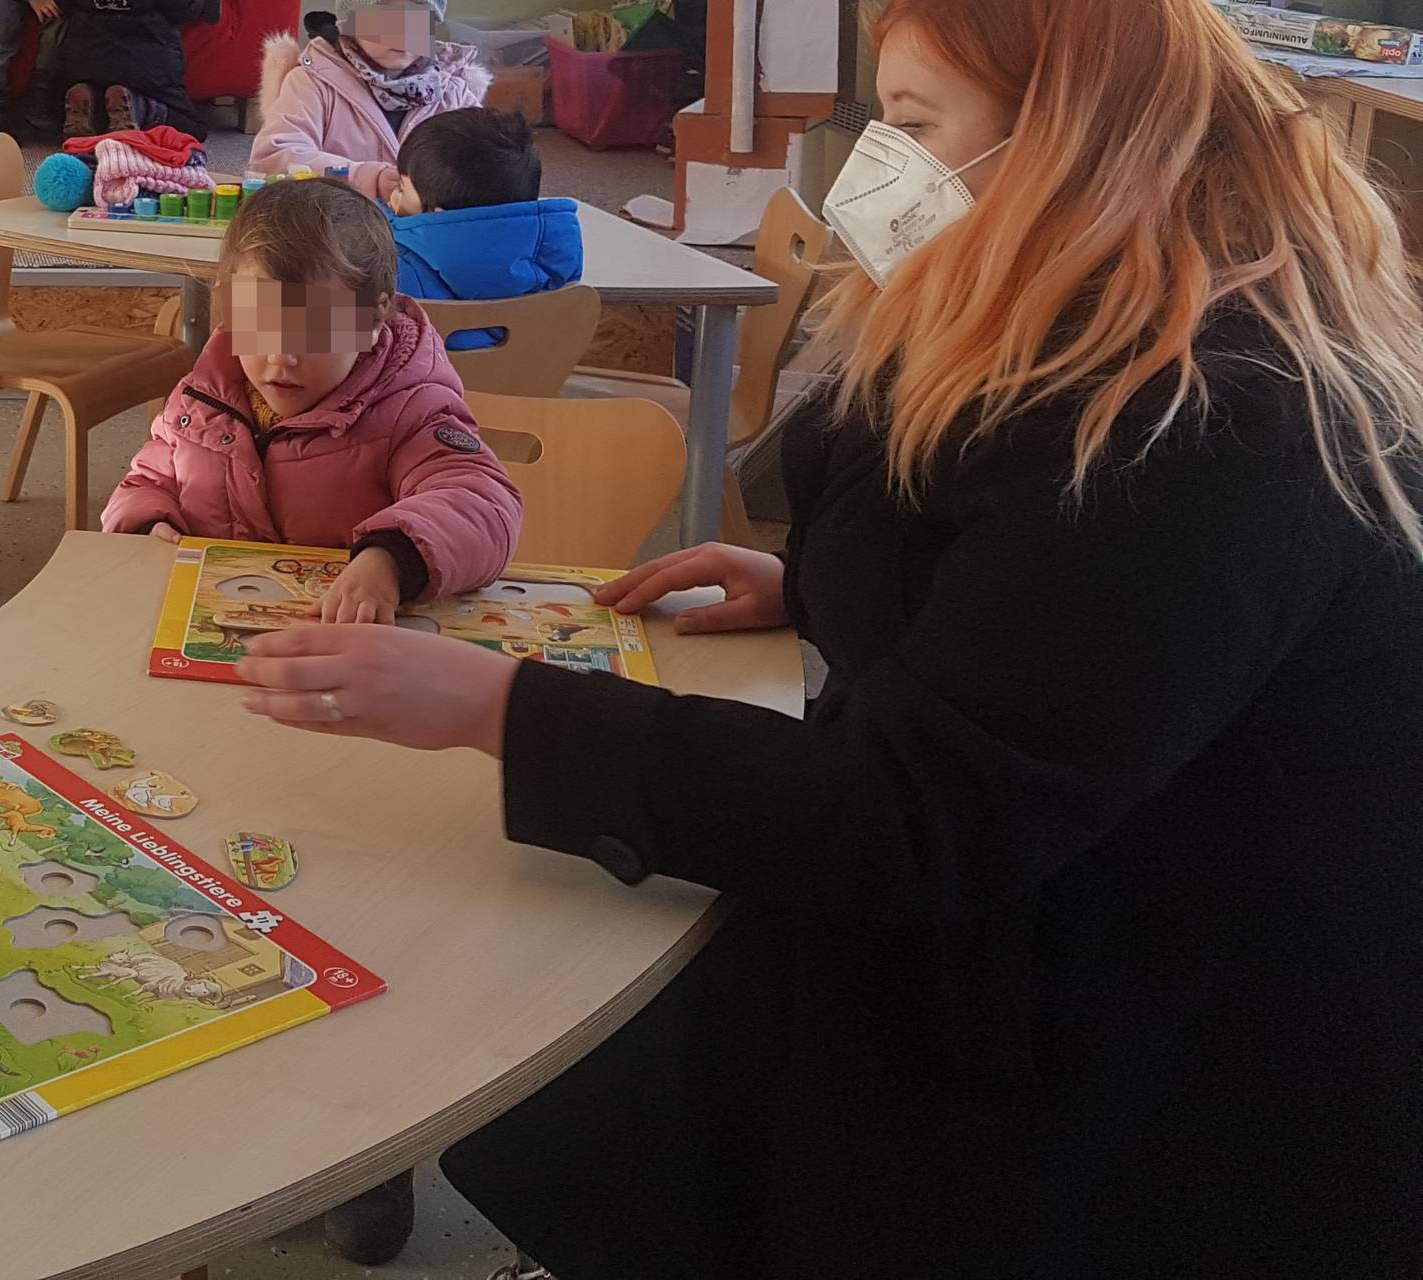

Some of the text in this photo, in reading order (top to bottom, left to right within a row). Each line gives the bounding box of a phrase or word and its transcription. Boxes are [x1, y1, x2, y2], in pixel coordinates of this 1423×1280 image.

[1232, 25, 1308, 44] ALUMINIUMFO
[79, 799, 243, 908] Meine Lieblingstiere
[333, 969, 355, 984] 18+
